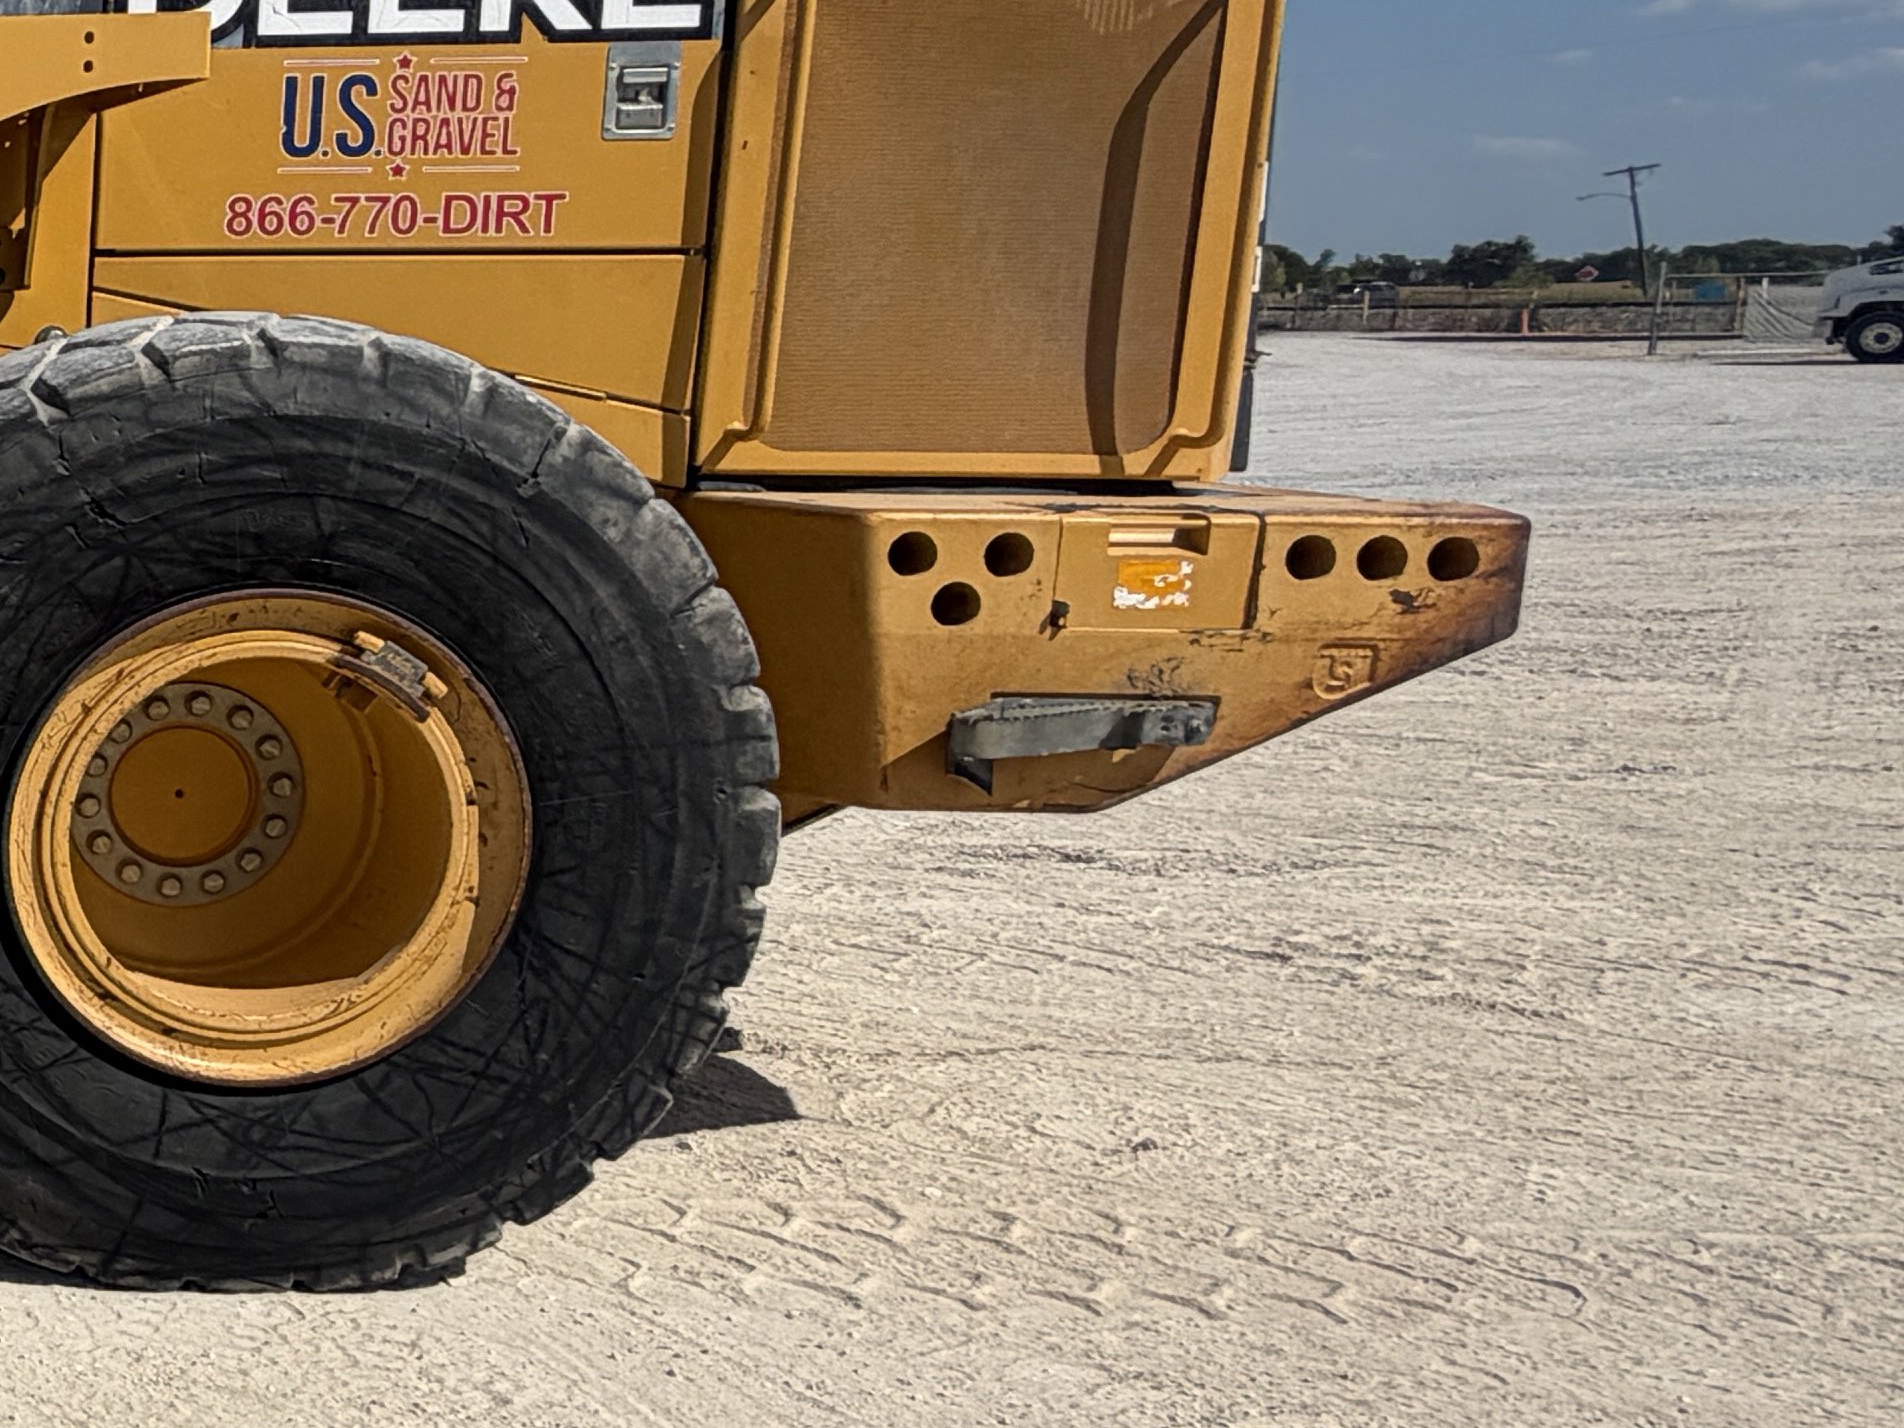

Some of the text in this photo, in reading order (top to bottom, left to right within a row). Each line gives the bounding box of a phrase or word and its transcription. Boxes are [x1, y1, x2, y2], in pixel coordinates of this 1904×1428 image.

[279, 72, 385, 159] U.S.
[388, 71, 519, 114] SAND &
[383, 113, 522, 158] GRAVEL
[224, 189, 570, 238] 866-770-DIRT
